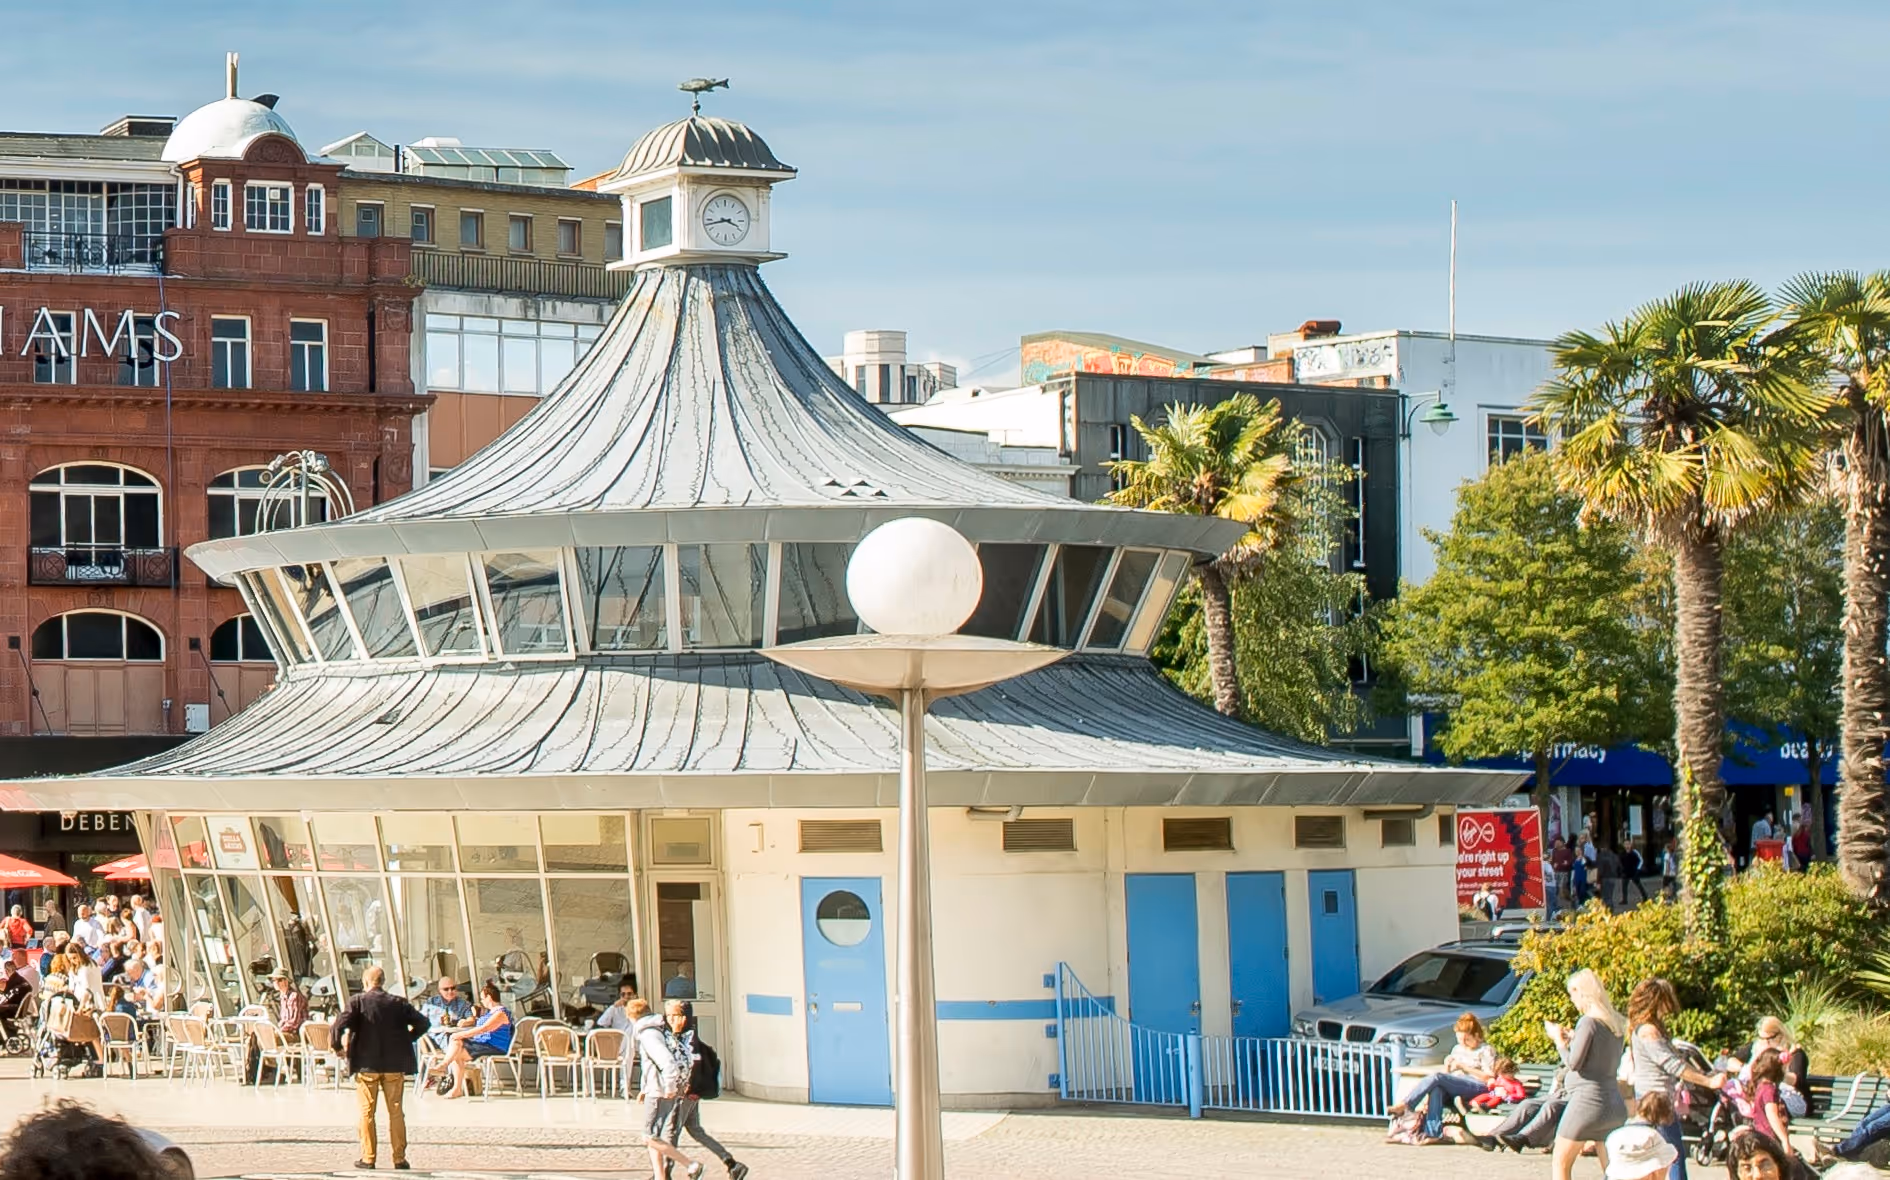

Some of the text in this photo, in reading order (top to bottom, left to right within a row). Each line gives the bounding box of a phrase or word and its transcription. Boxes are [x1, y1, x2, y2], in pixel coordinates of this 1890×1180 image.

[1475, 849, 1496, 865] right
[1497, 852, 1510, 865] up
[1457, 865, 1504, 881] your street
